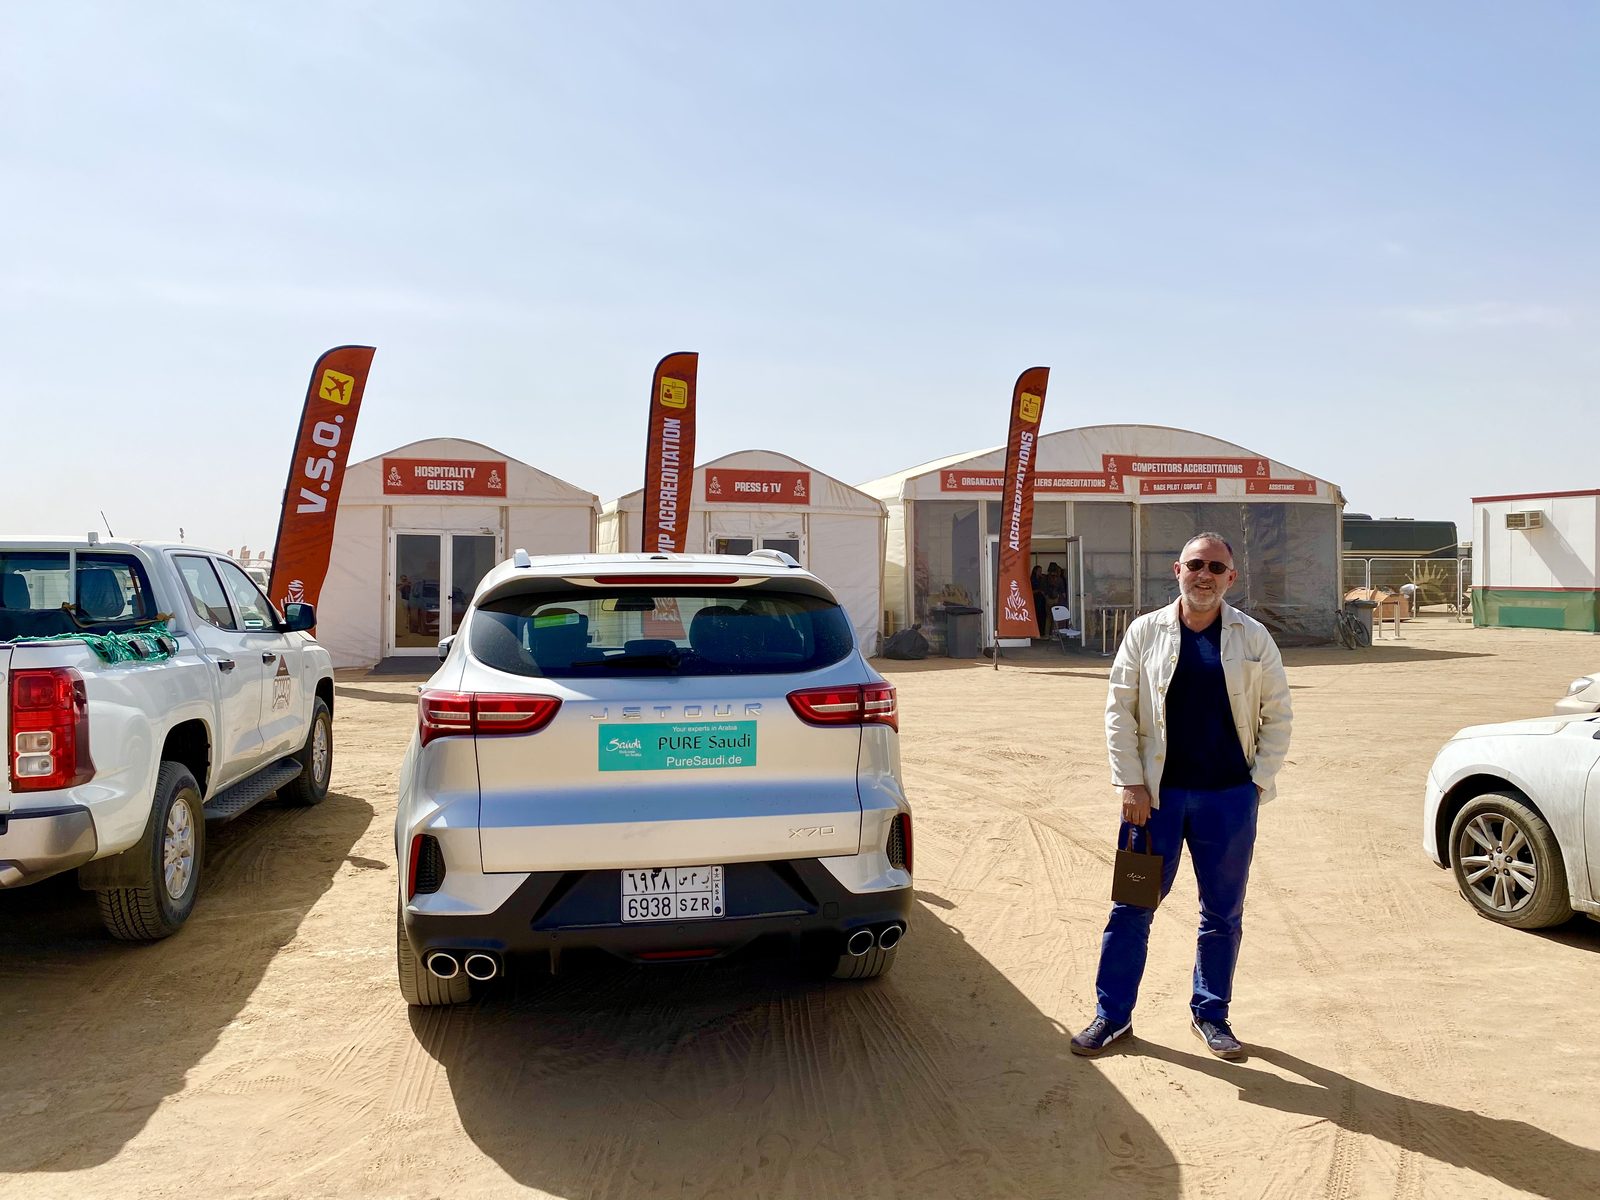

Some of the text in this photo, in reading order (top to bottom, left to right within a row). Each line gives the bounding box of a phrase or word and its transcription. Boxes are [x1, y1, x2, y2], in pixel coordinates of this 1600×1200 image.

[297, 415, 344, 513] V.S.O.
[1132, 462, 1182, 473] COMPETITORS
[1183, 463, 1243, 474] ACCREDITATIONS
[415, 466, 476, 478] HOSPITALITY
[658, 417, 680, 532] ACCREDITATION
[427, 479, 464, 491] GUESTS
[735, 481, 781, 493] PRESS & TV
[961, 477, 1004, 486] ORGANIZATIO
[1053, 478, 1106, 487] ACCREDITATIONS
[1009, 431, 1034, 551] ACCREDITATIONS
[1004, 606, 1031, 622] DAKAR
[590, 703, 763, 720] JETOUR
[688, 725, 710, 733] experts
[606, 738, 642, 752] Saudi
[658, 734, 751, 750] PURE Saudi
[666, 755, 743, 767] PureSaudi.de
[789, 825, 835, 838] X70
[628, 897, 710, 918] 6938 SZR
